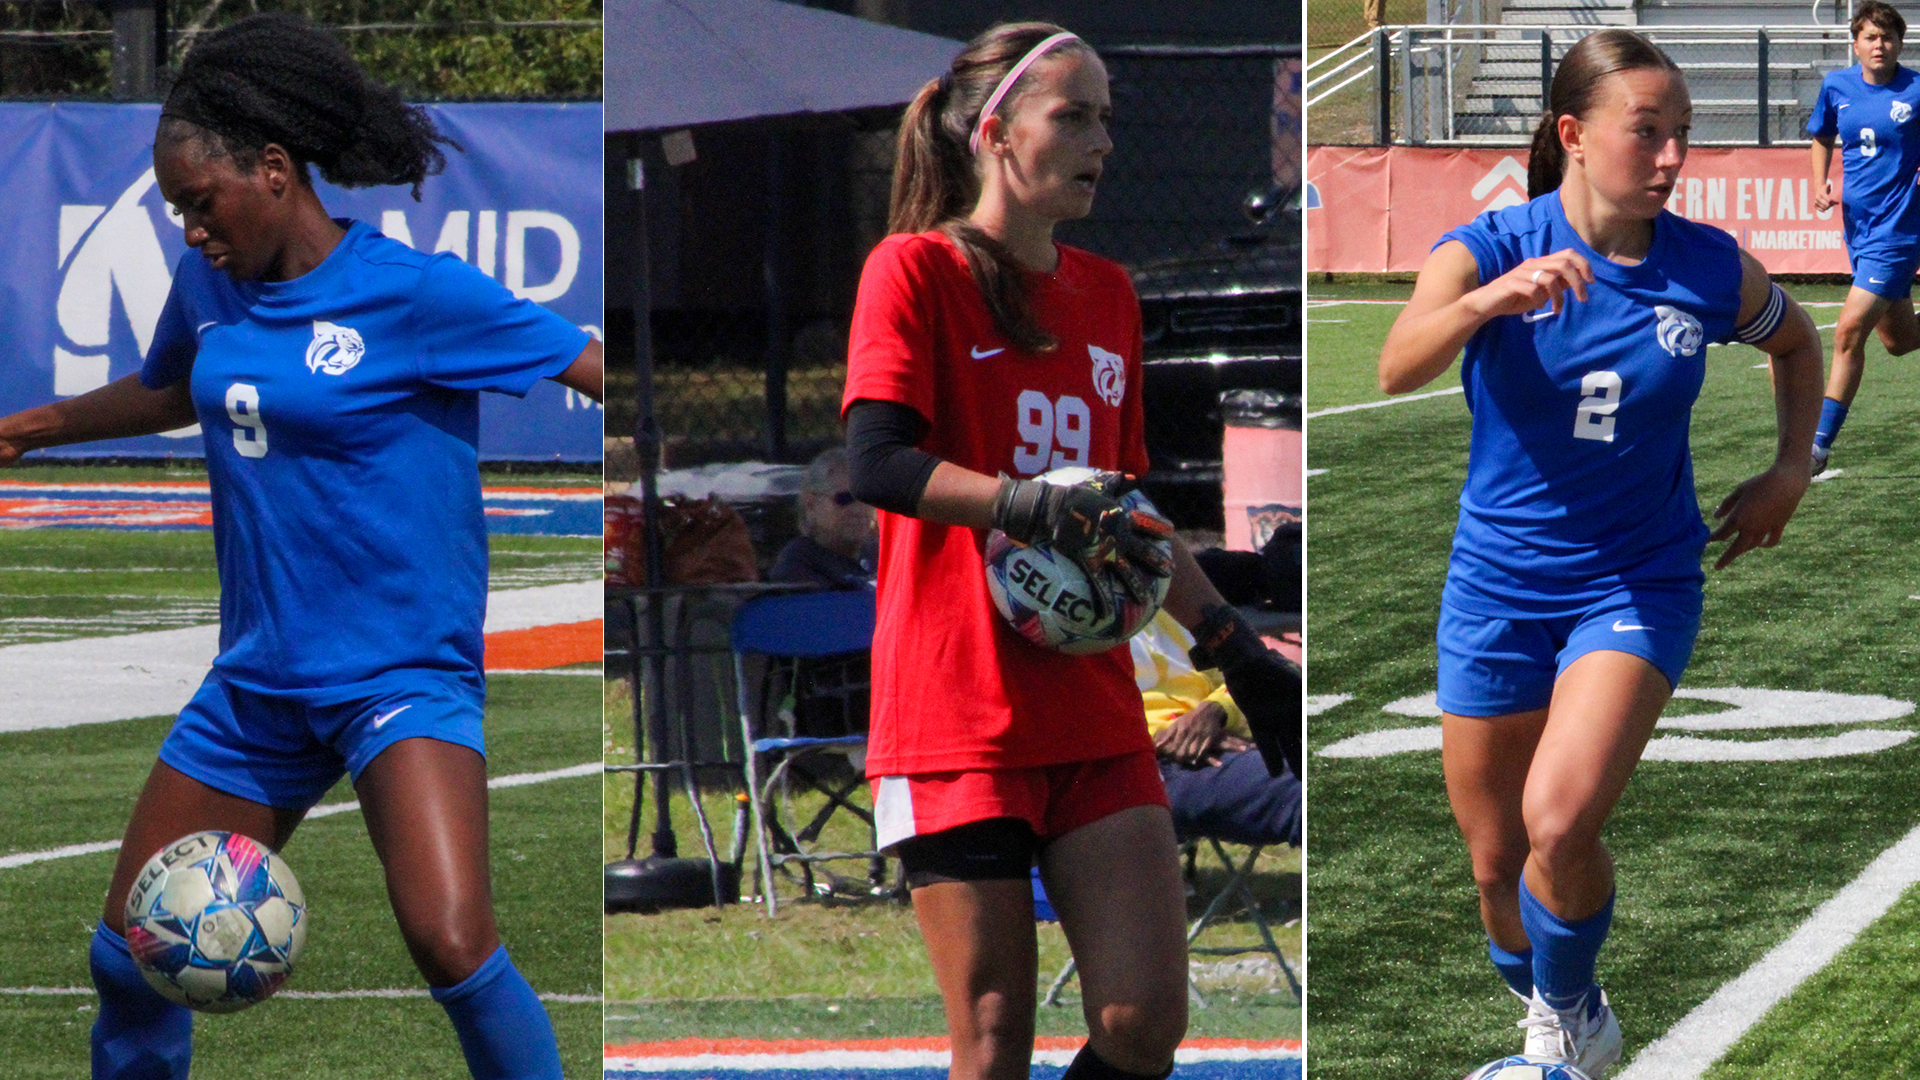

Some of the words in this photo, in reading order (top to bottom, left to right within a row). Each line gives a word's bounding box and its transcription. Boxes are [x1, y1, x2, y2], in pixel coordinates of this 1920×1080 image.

[1751, 229, 1842, 251] MARKETING
[225, 383, 269, 459] 9
[1013, 389, 1091, 475] 99
[1573, 370, 1623, 443] 2
[130, 835, 210, 912] SELECT
